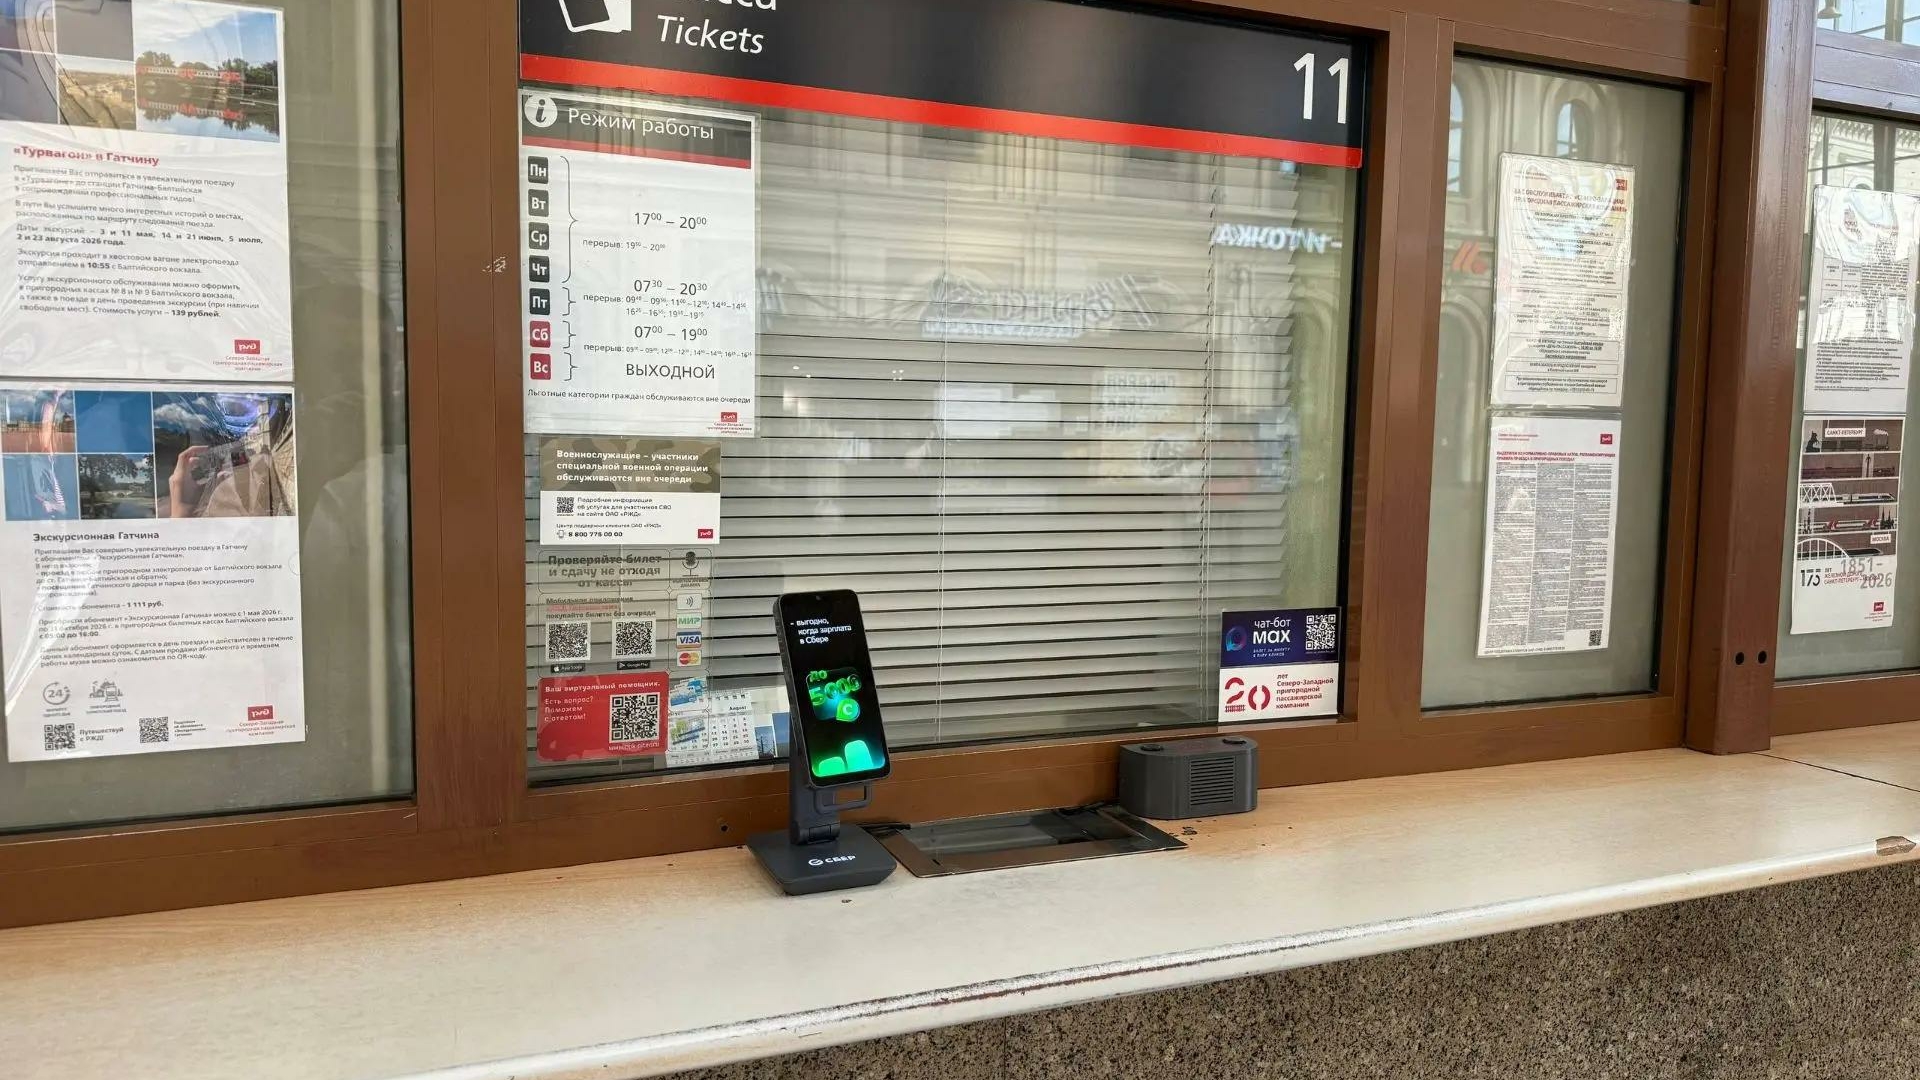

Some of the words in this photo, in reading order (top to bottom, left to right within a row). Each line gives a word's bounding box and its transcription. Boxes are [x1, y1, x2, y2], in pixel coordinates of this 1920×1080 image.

[657, 14, 765, 54] Tickets
[1293, 52, 1349, 124] 11
[568, 107, 636, 131] Режим
[642, 117, 714, 140] работы
[106, 152, 159, 166] Гатчину
[530, 163, 547, 177] Пн
[532, 197, 546, 210] Вт
[161, 231, 171, 239] 14
[186, 233, 196, 241] 21
[530, 230, 547, 247] Ср
[582, 239, 623, 249] перерыв:
[87, 261, 110, 270] 10:55
[532, 263, 548, 276] Чт
[532, 295, 548, 309] Пт
[583, 294, 623, 303] перерыв:
[171, 309, 186, 317] 139
[532, 327, 549, 341] Сб
[583, 344, 624, 353] перерыв:
[533, 361, 549, 373] Вс
[626, 362, 716, 380] ВЫХОДНОЙ
[527, 388, 567, 398] Льготные
[568, 390, 610, 399] категории
[611, 392, 644, 400] граждан
[645, 393, 705, 402] обслуживаются
[556, 449, 641, 461] Военнослужащие
[651, 453, 699, 462] участники
[556, 462, 621, 473] специальной
[622, 464, 662, 472] военной
[556, 474, 633, 484] обслуживаются
[653, 476, 692, 485] очереди
[33, 533, 115, 543] Экскурсионная
[118, 531, 160, 540] Гатчина
[548, 555, 623, 566] Проверяйте
[625, 553, 663, 564] билет
[548, 568, 558, 577] и
[561, 568, 598, 578] сдачу
[600, 567, 616, 576] не
[618, 566, 661, 576] отходя
[1800, 568, 1821, 587] 175
[577, 580, 592, 588] от
[1860, 572, 1893, 589] 2026
[678, 617, 701, 625] МИР
[796, 618, 829, 627] выгодно,
[1254, 616, 1292, 629] чат-бот
[798, 628, 819, 636] когда
[820, 625, 852, 634] зарплата
[679, 635, 700, 644] VISA
[805, 635, 829, 644] Сбере
[564, 682, 616, 692] виртуальный
[1276, 678, 1335, 687] Северо-Западной
[1276, 686, 1320, 695] пригородной
[564, 695, 594, 704] вопрос?
[1276, 694, 1323, 703] пассажирской
